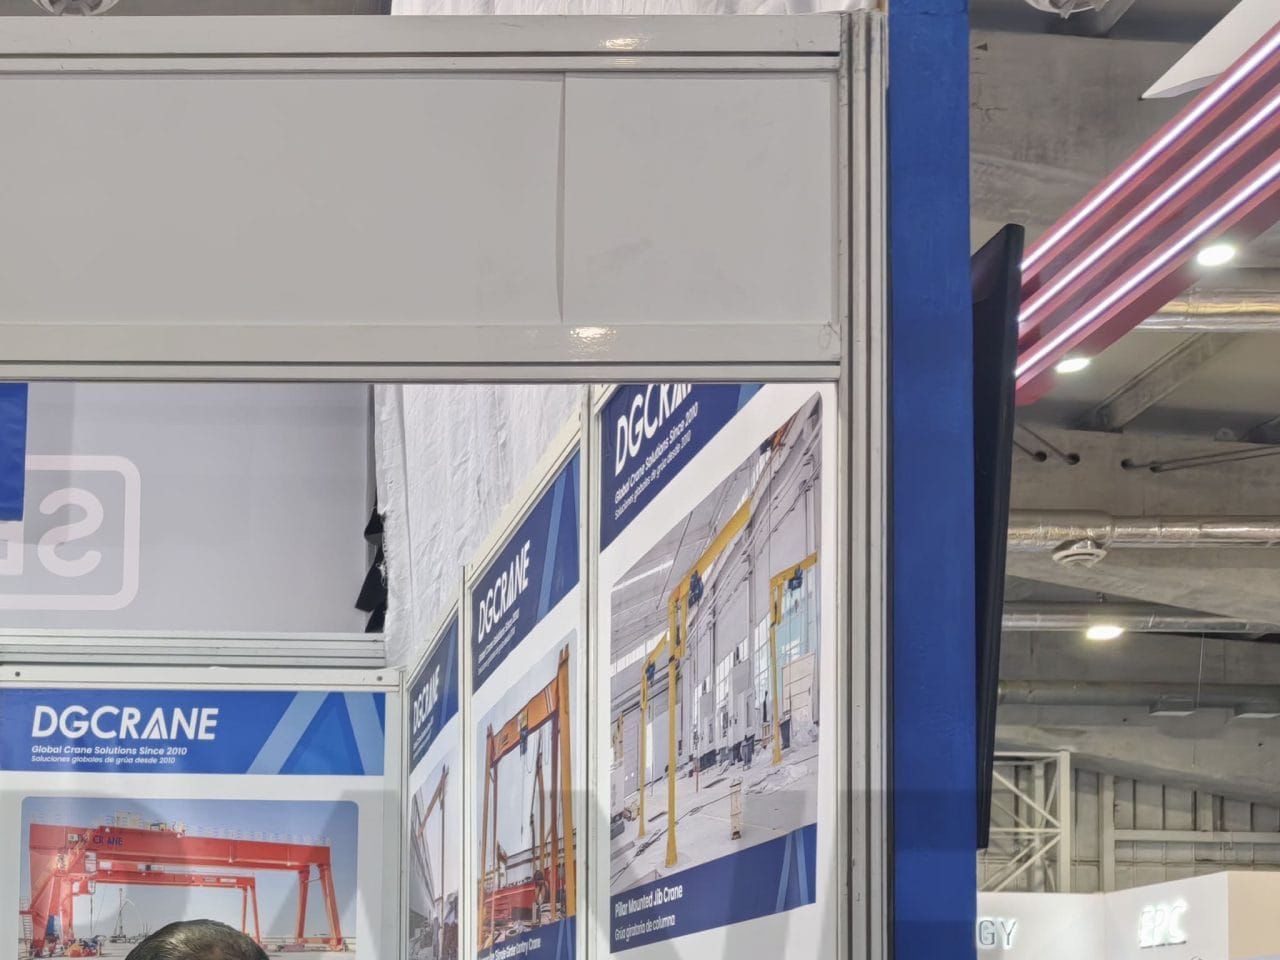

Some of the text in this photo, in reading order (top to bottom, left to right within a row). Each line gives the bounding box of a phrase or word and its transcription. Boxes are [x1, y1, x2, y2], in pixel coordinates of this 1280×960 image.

[478, 540, 530, 644] DGCRANE
[31, 705, 219, 741] DGCRANE
[31, 745, 188, 756] Global Crane Solutions Since 2010
[31, 755, 70, 763] Soluciones
[71, 755, 103, 764] globales
[104, 755, 114, 763] de
[116, 756, 134, 765] grúa
[134, 756, 158, 764] desde
[615, 901, 628, 918] Pillar
[628, 890, 653, 914] Mounted
[663, 885, 683, 903] Crane
[646, 919, 652, 933] de
[652, 914, 676, 931] columna
